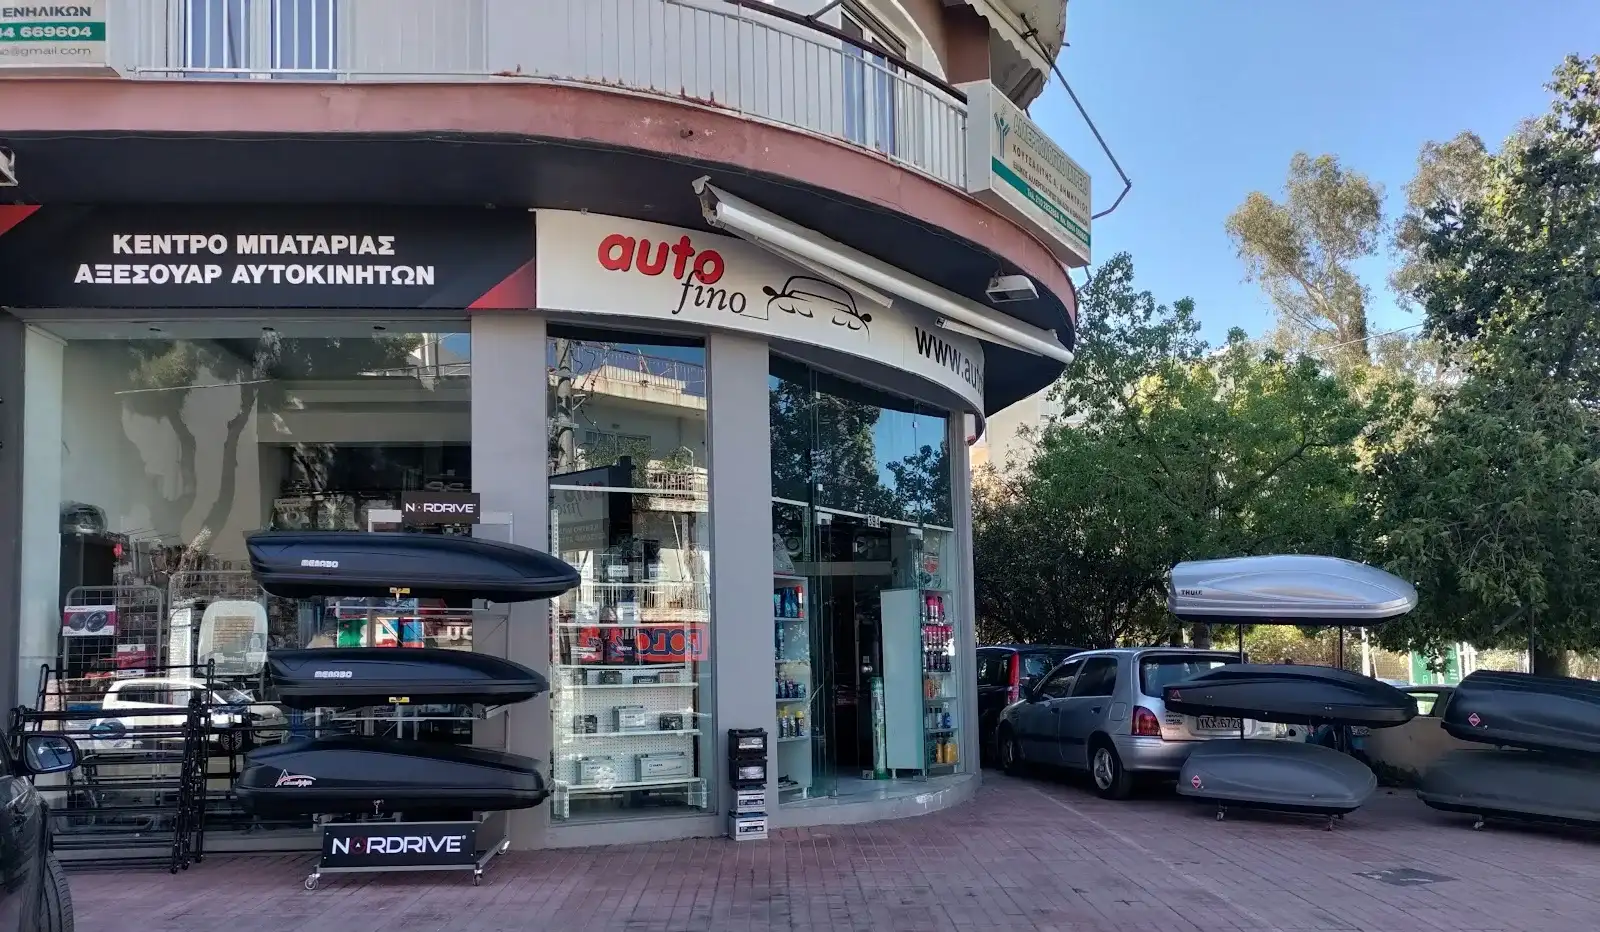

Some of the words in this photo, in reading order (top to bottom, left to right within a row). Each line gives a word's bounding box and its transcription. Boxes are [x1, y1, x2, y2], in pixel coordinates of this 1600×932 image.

[3, 7, 91, 17] ΕΝΗΛΙΚΩΝ
[20, 26, 92, 38] 669604
[113, 234, 228, 254] ΚΕΝΤΡΟ
[236, 235, 395, 255] ΜΠΑΤΑΡΙΑΣ
[598, 234, 724, 284] auto
[74, 264, 222, 284] ΑΞΕΣΟΥΑΡ
[231, 264, 434, 285] ΑΥΤΟΚΙΝΗΤΩΝ
[672, 270, 746, 314] fino
[405, 503, 474, 513] NORDRIVE
[331, 836, 461, 854] NORDRIVE
